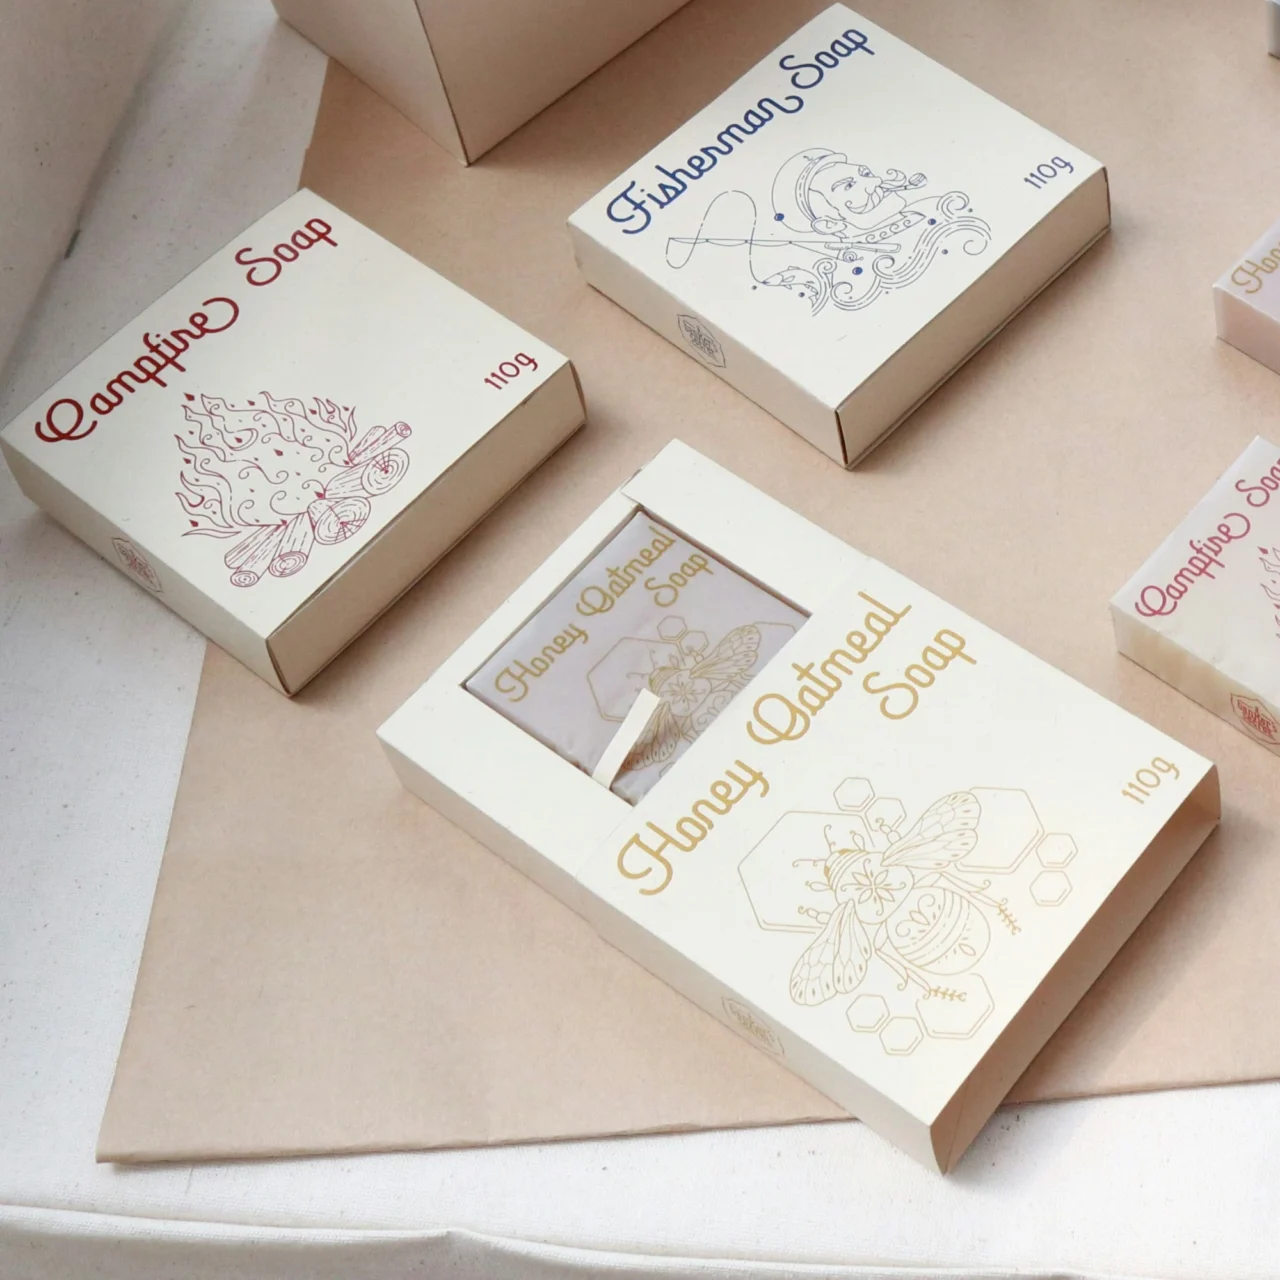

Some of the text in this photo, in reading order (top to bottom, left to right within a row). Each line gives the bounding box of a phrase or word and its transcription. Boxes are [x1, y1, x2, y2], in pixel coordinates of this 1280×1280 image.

[606, 28, 876, 235] Fisherman Soap
[1023, 154, 1074, 190] 110g
[34, 217, 338, 443] Campfire Soap
[483, 351, 538, 390] 110g
[644, 553, 714, 607] Soap
[1135, 512, 1251, 617] Campfire
[494, 526, 676, 703] Honey Oatmeal
[862, 627, 977, 720] Soap
[616, 592, 912, 896] Honey Oatmeal
[1121, 755, 1181, 805] 110g
